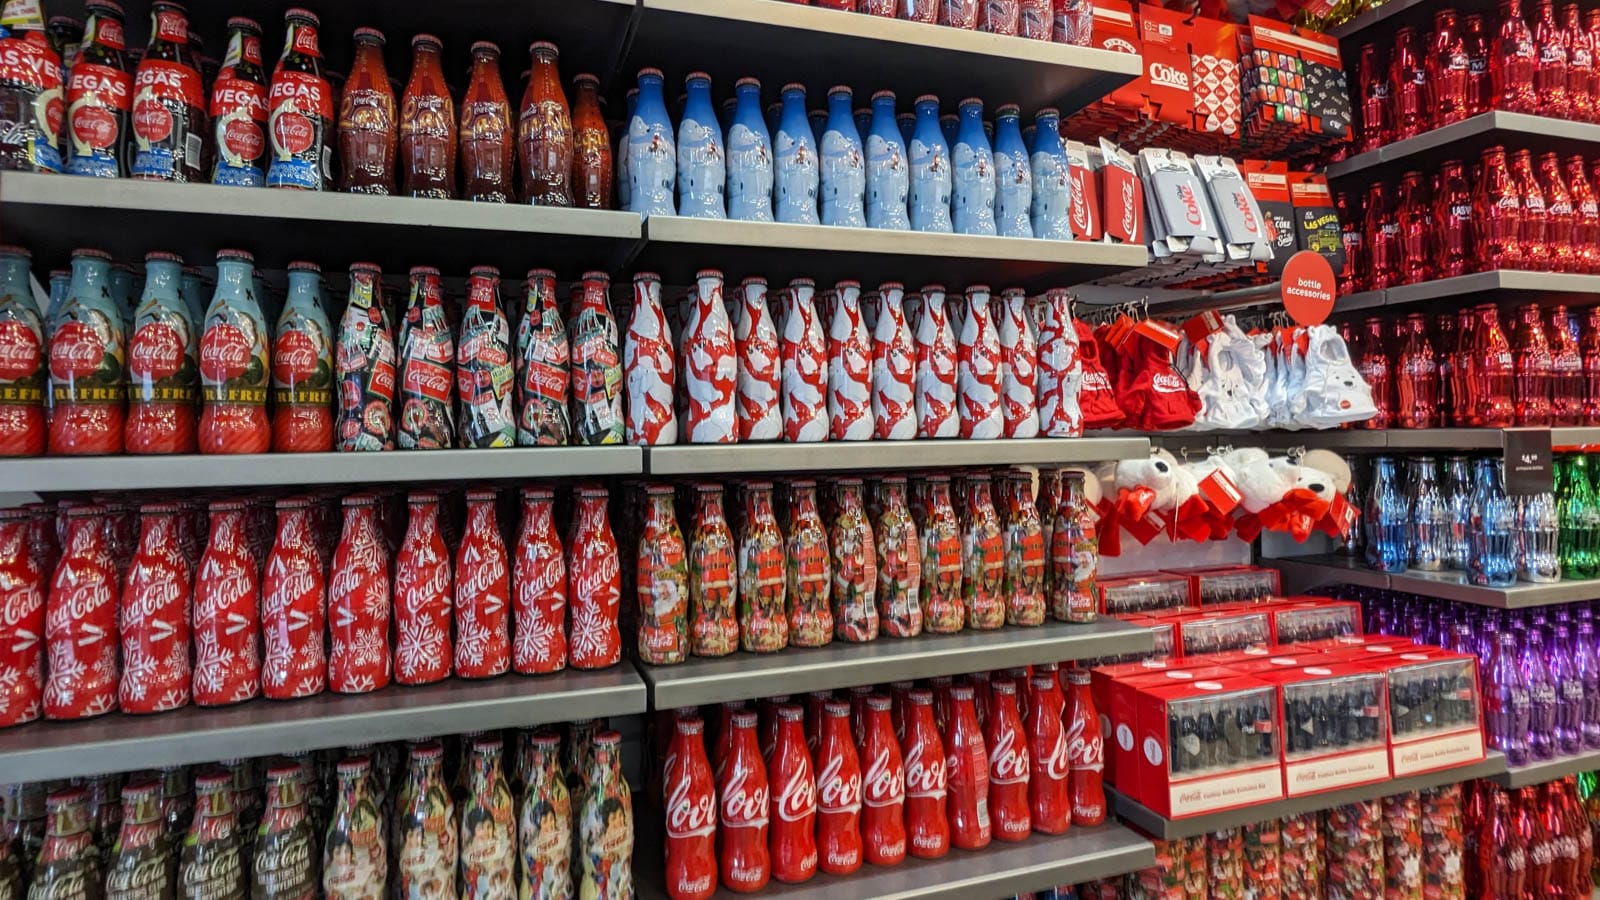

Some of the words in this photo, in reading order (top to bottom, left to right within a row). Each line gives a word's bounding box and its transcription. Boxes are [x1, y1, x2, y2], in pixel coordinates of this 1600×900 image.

[134, 69, 183, 88] EGAS
[1149, 62, 1188, 85] Coke
[70, 74, 127, 97] EGAS
[214, 90, 269, 111] VEGAS
[1072, 177, 1087, 230] Coca-Cola
[1121, 179, 1134, 235] Coca-Cola
[1181, 183, 1202, 226] Coke
[1237, 191, 1257, 233] Coke
[1304, 219, 1318, 230] LAS
[1317, 214, 1339, 227] VEGAS
[1286, 287, 1331, 303] accessories
[1298, 277, 1322, 290] bottle
[202, 343, 245, 362] Coca-Cola
[275, 348, 312, 366] Coca-Cola
[408, 371, 448, 395] Coca-Cola
[530, 373, 563, 395] Coca-Cola
[406, 560, 451, 613] Coca-Co
[456, 550, 504, 609] Coca-Cola
[519, 551, 566, 606] Coca-Col
[577, 551, 620, 602] Coca-Col
[194, 565, 251, 629] Coca-Cola
